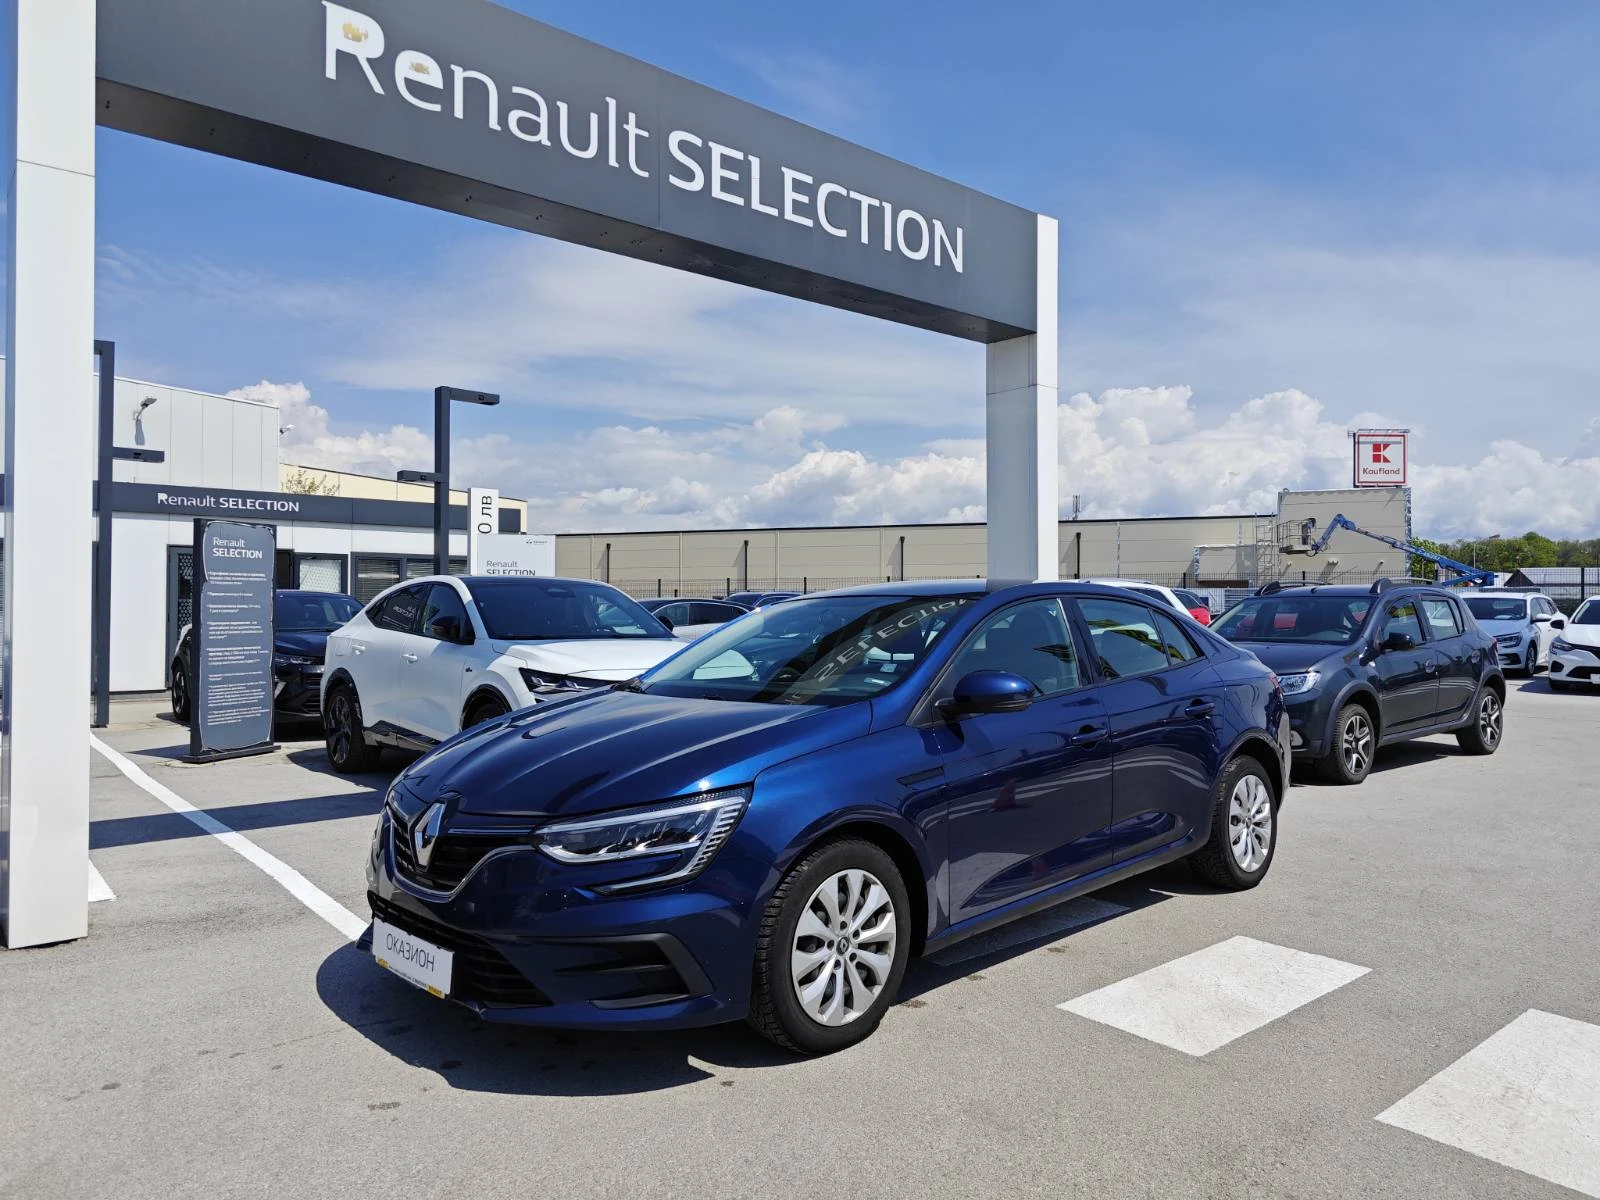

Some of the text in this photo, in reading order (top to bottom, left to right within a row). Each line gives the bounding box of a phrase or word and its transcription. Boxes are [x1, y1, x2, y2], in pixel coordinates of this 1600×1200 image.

[321, 0, 964, 274] Renault SELECTION
[1362, 467, 1400, 475] Kaufland
[157, 492, 299, 512] Renault SELECTION
[213, 536, 246, 548] Renault
[212, 548, 263, 559] SELECTION
[486, 560, 518, 568] Renault
[386, 933, 435, 973] ОКАЗИОН
